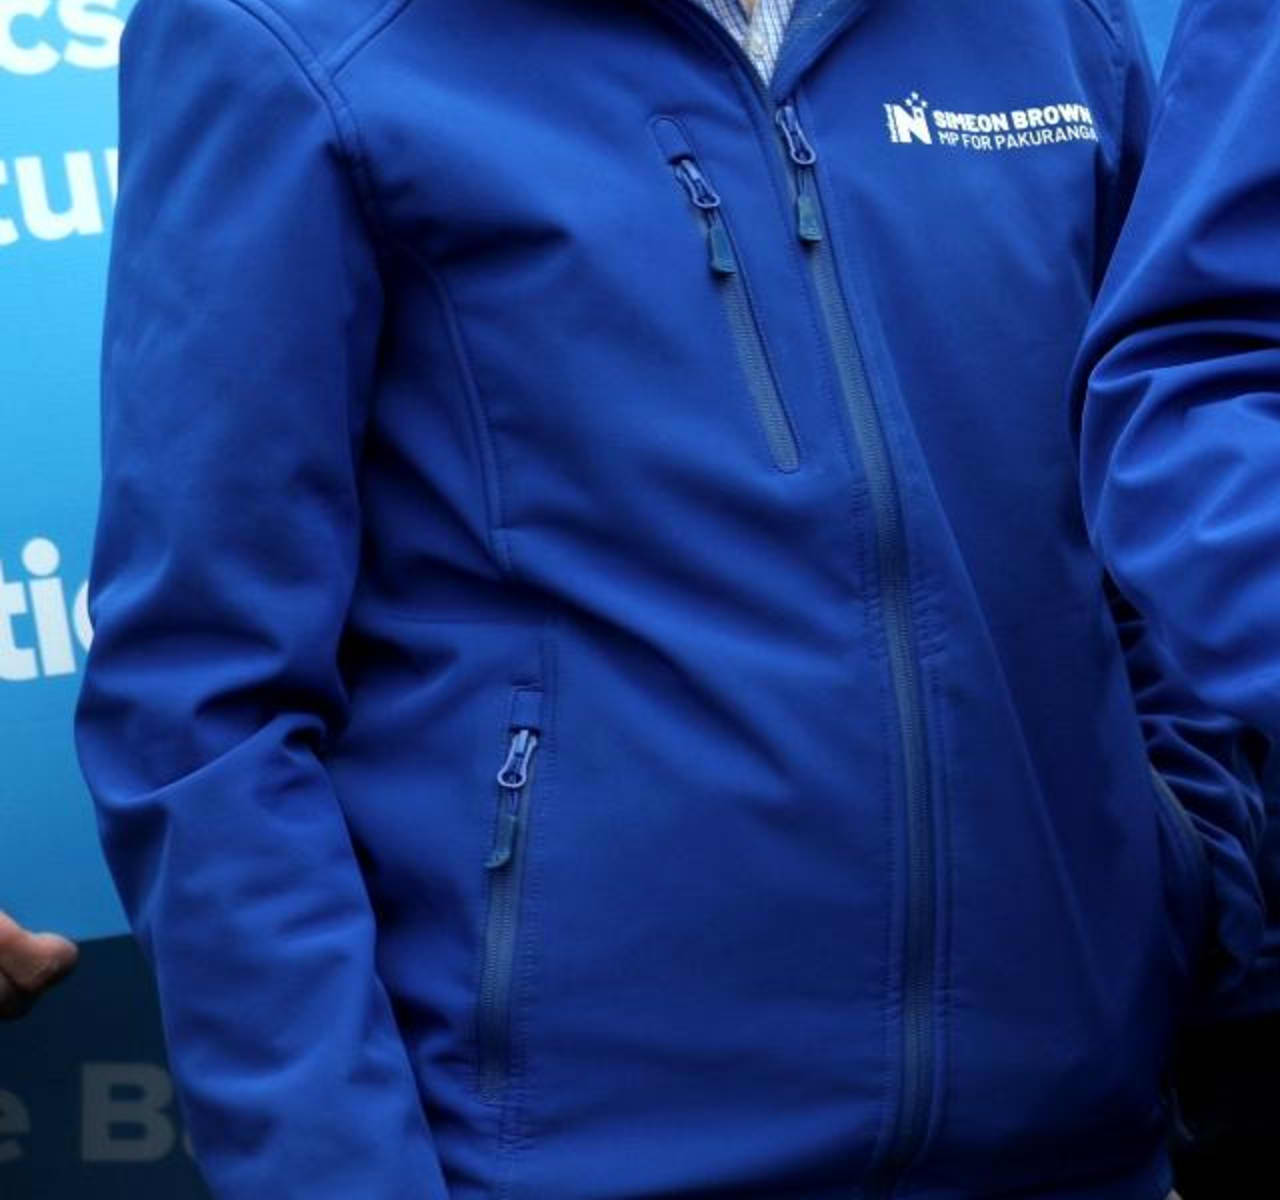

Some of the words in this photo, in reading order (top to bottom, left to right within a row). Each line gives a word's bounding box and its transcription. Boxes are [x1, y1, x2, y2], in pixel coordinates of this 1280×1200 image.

[933, 109, 1009, 133] SIMEON
[1011, 103, 1093, 129] BROWN
[939, 131, 960, 146] MP
[963, 133, 993, 150] FOR
[995, 125, 1099, 150] PAKURANGA
